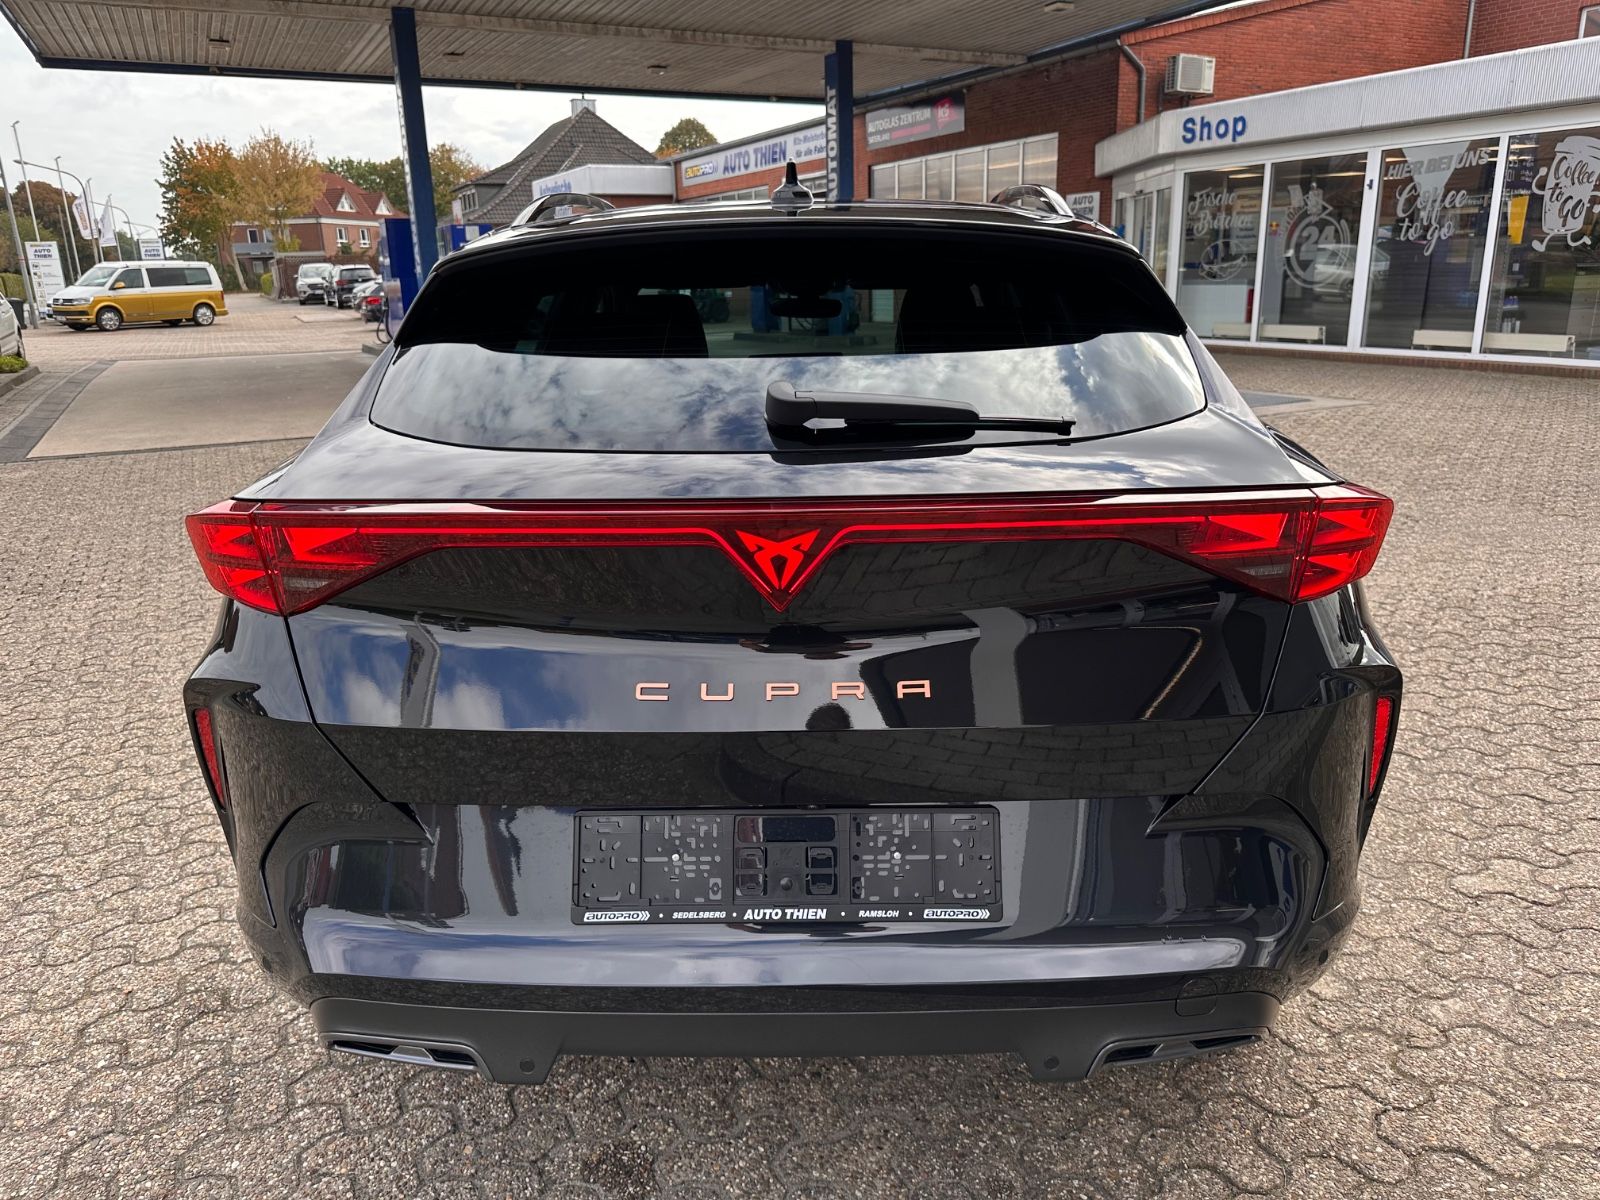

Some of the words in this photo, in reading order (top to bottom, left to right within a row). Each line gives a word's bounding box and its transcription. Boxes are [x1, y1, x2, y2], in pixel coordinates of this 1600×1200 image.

[868, 115, 899, 133] AUTOGLAS
[900, 107, 931, 126] ZENTRUM
[1181, 114, 1247, 144] Shop
[723, 149, 750, 175] AUTO
[753, 140, 787, 168] THIEN
[1387, 161, 1424, 178] HIER
[1424, 155, 1453, 174] BEI
[1456, 149, 1491, 168] UNS
[1554, 156, 1596, 186] Coffee
[1072, 195, 1094, 206] AUTO
[1396, 182, 1467, 226] Coffee
[1299, 225, 1336, 261] 24
[1400, 217, 1423, 241] to
[1424, 220, 1454, 256] go
[635, 679, 931, 701] CUPRA
[672, 911, 727, 920] SEDELSBERG
[744, 908, 782, 921] AUTO
[784, 908, 827, 920] THIEN
[858, 909, 900, 918] RAMSLOH
